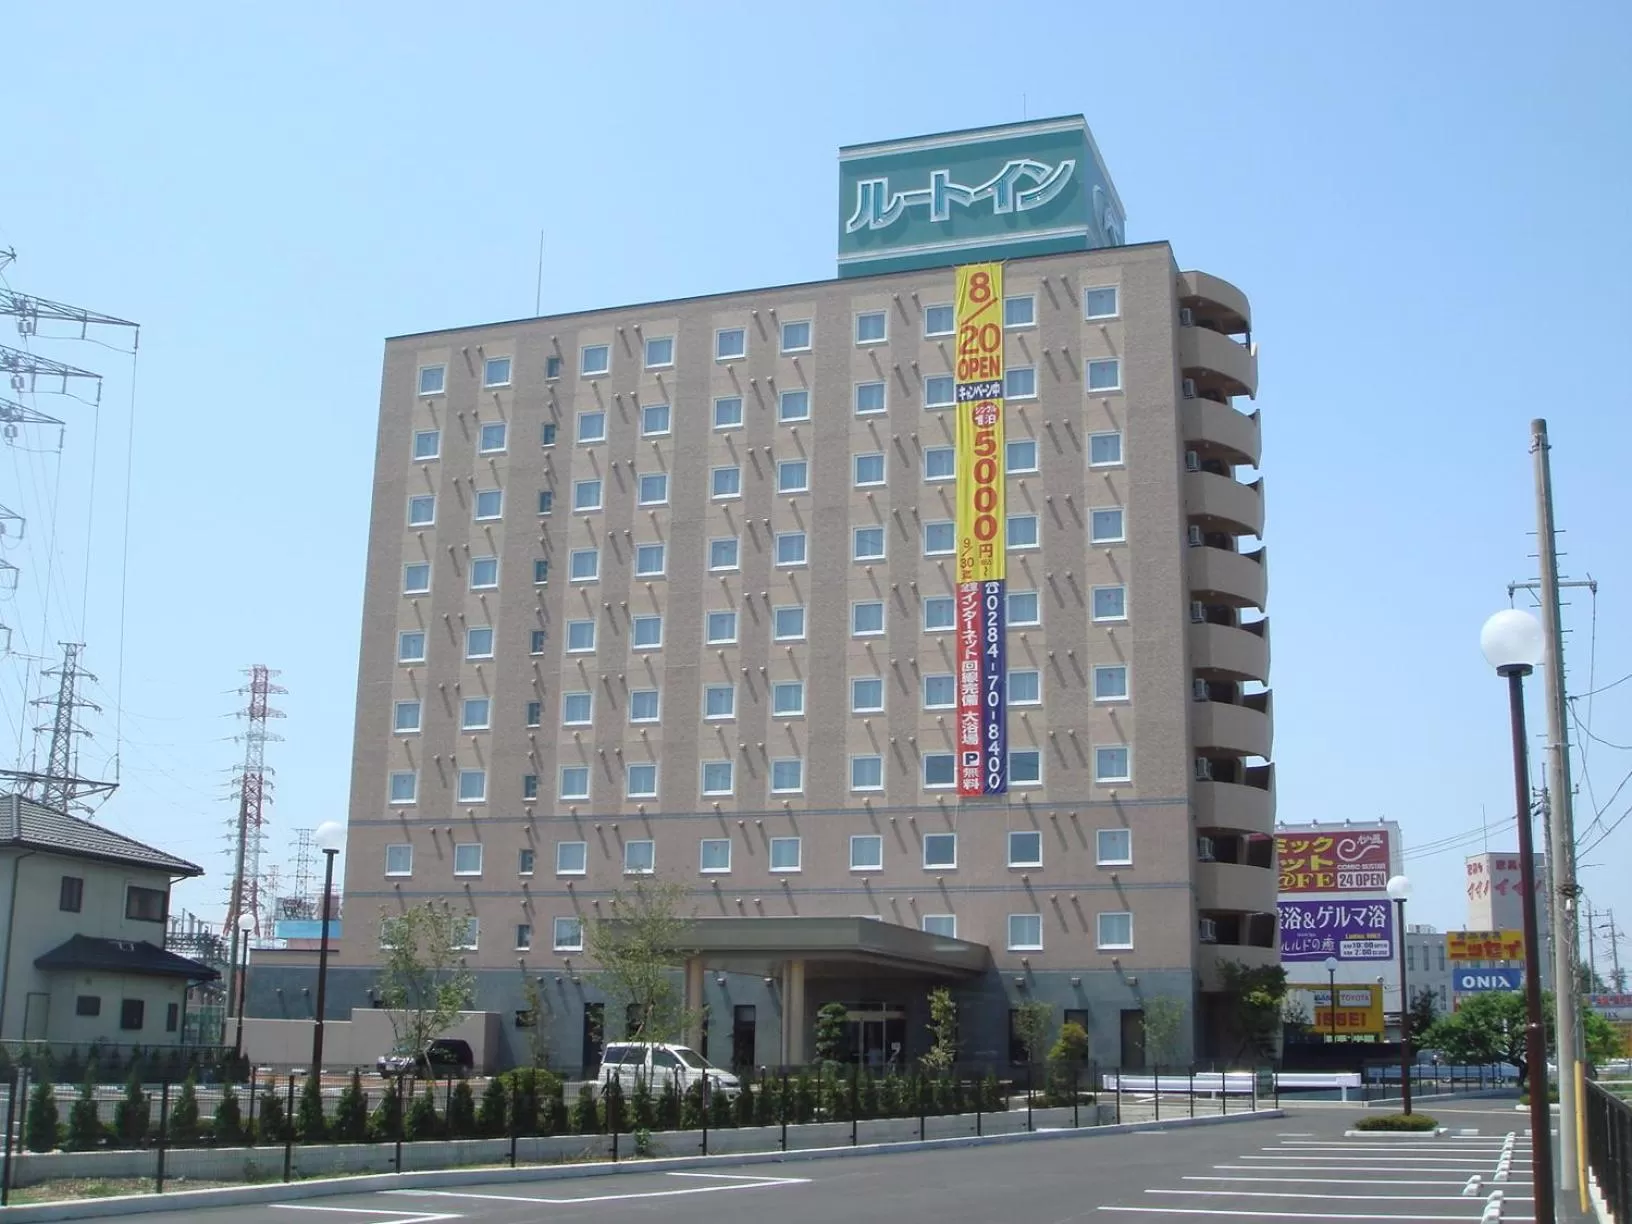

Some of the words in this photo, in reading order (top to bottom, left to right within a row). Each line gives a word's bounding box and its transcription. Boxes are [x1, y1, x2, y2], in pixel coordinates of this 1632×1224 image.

[846, 158, 1076, 233] ルートイン
[957, 355, 1001, 381] OPEN
[958, 381, 1001, 401] キャンペーン中
[1340, 873, 1354, 887] 24
[1355, 872, 1386, 887] OPEN
[1449, 940, 1522, 959] ニッセイ
[1461, 975, 1512, 989] ONIX
